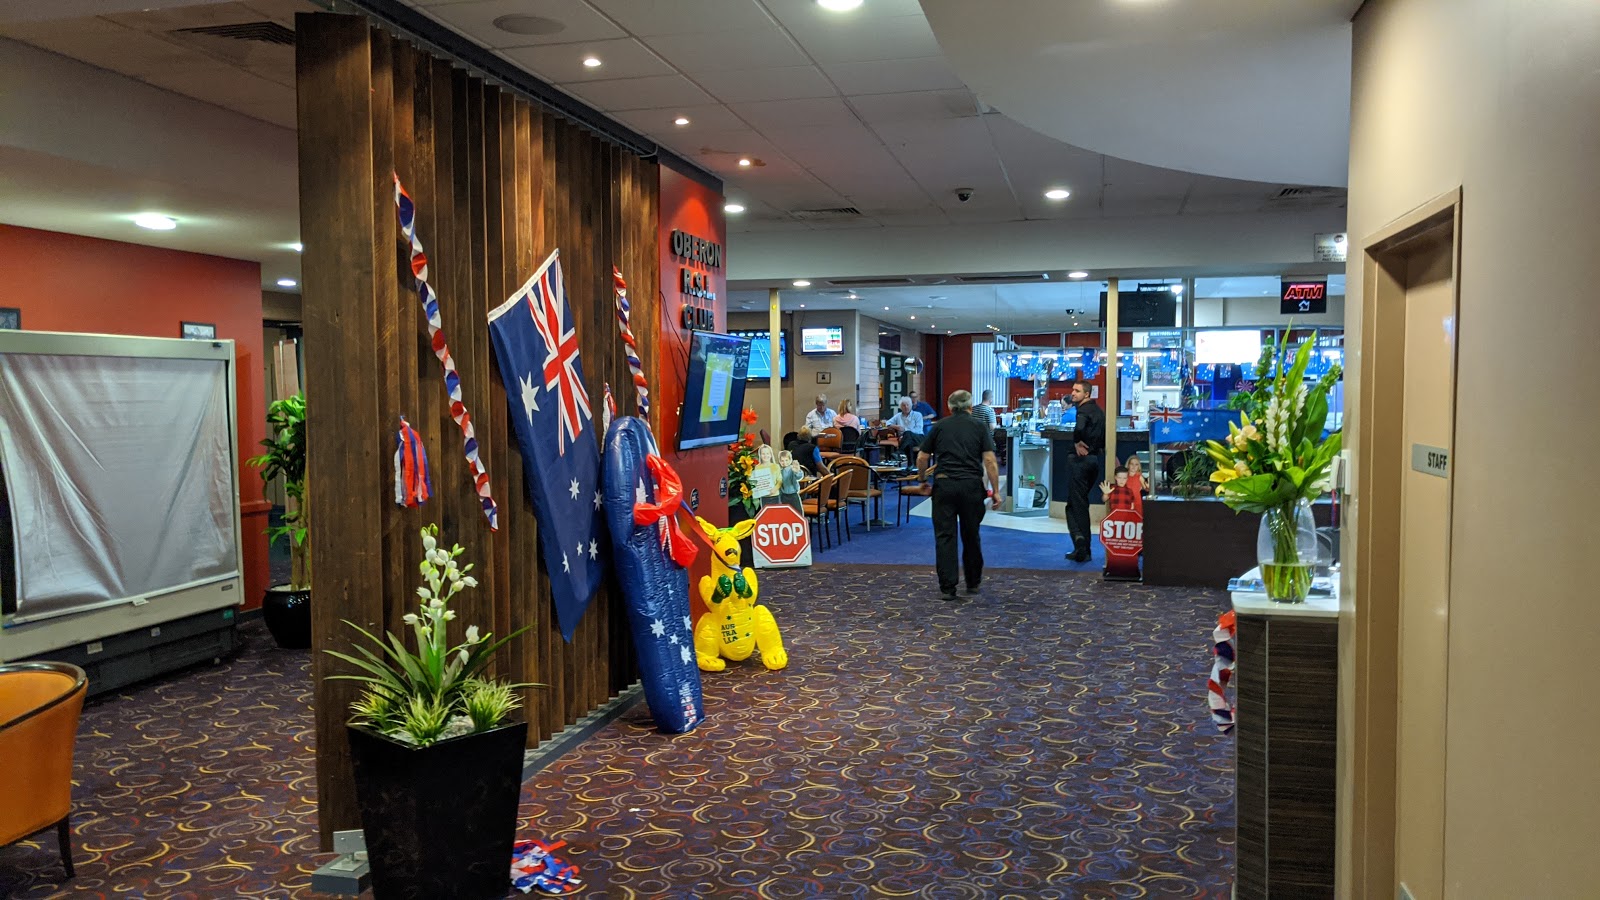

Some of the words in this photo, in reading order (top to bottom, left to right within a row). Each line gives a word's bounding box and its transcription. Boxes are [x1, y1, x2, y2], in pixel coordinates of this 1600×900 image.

[670, 229, 721, 267] OBERON
[1283, 284, 1324, 300] ATM
[681, 304, 715, 331] CLUB
[1427, 451, 1448, 471] STAFF
[757, 522, 804, 547] STOP
[721, 623, 736, 631] AUS
[721, 629, 738, 637] TRA
